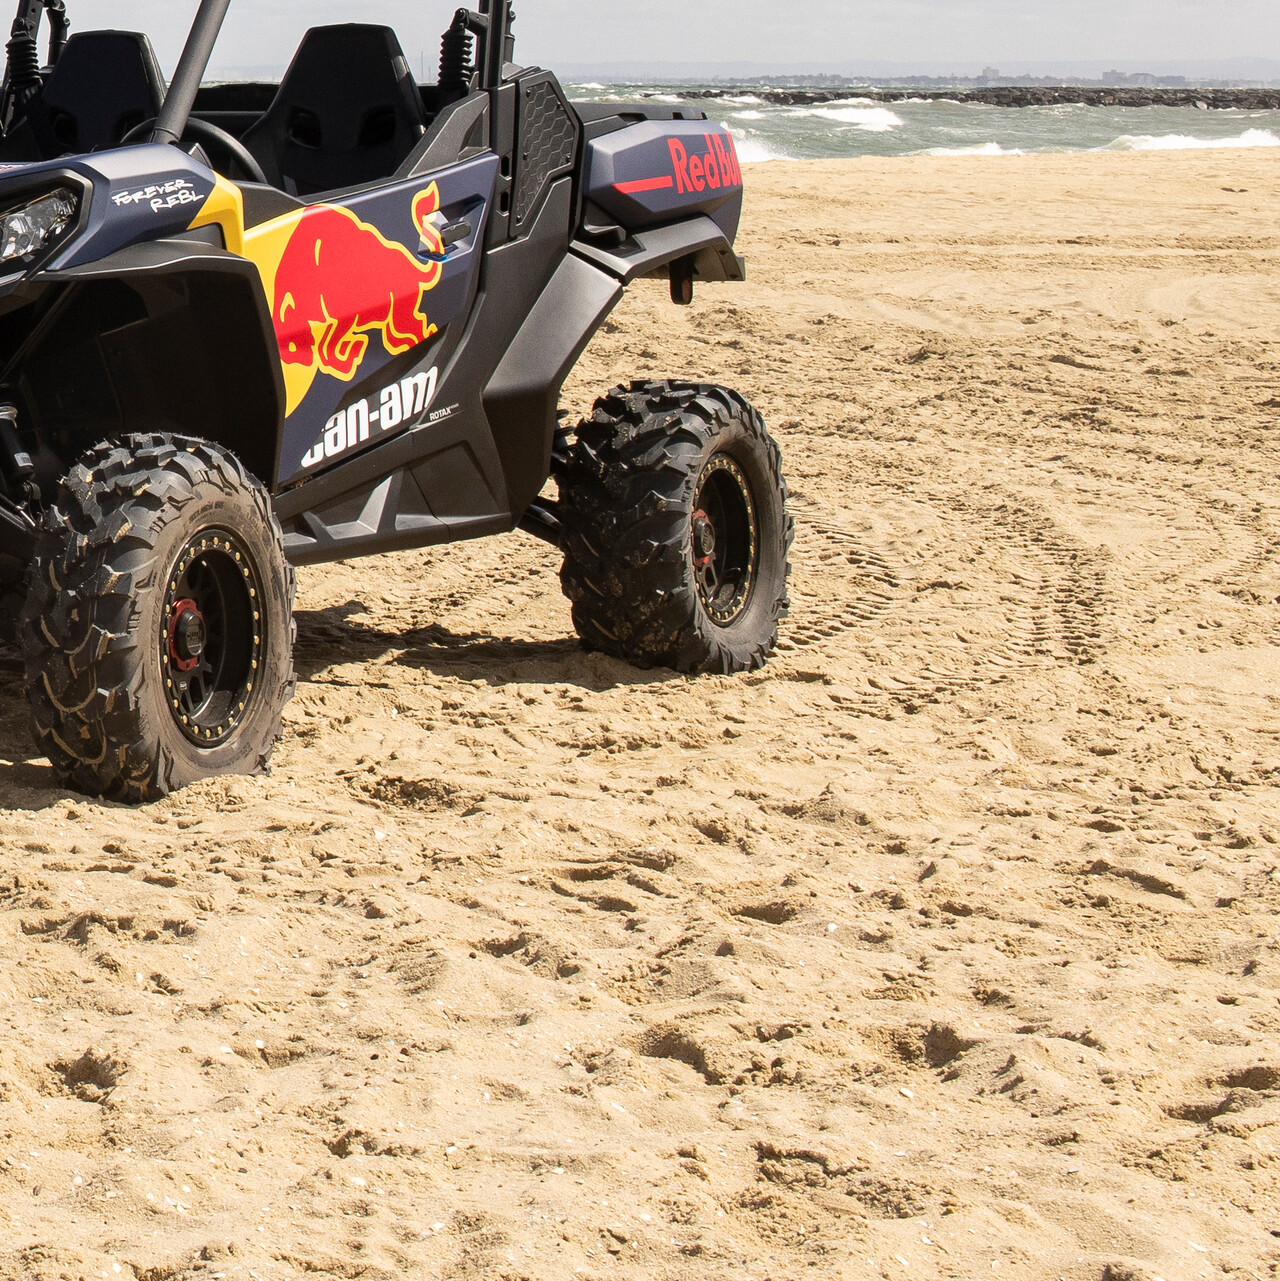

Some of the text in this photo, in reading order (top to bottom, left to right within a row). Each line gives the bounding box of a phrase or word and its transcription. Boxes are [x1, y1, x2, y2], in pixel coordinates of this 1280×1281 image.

[111, 179, 194, 206] FOREVER
[150, 189, 205, 213] REBL
[429, 406, 452, 421] ROTAX
